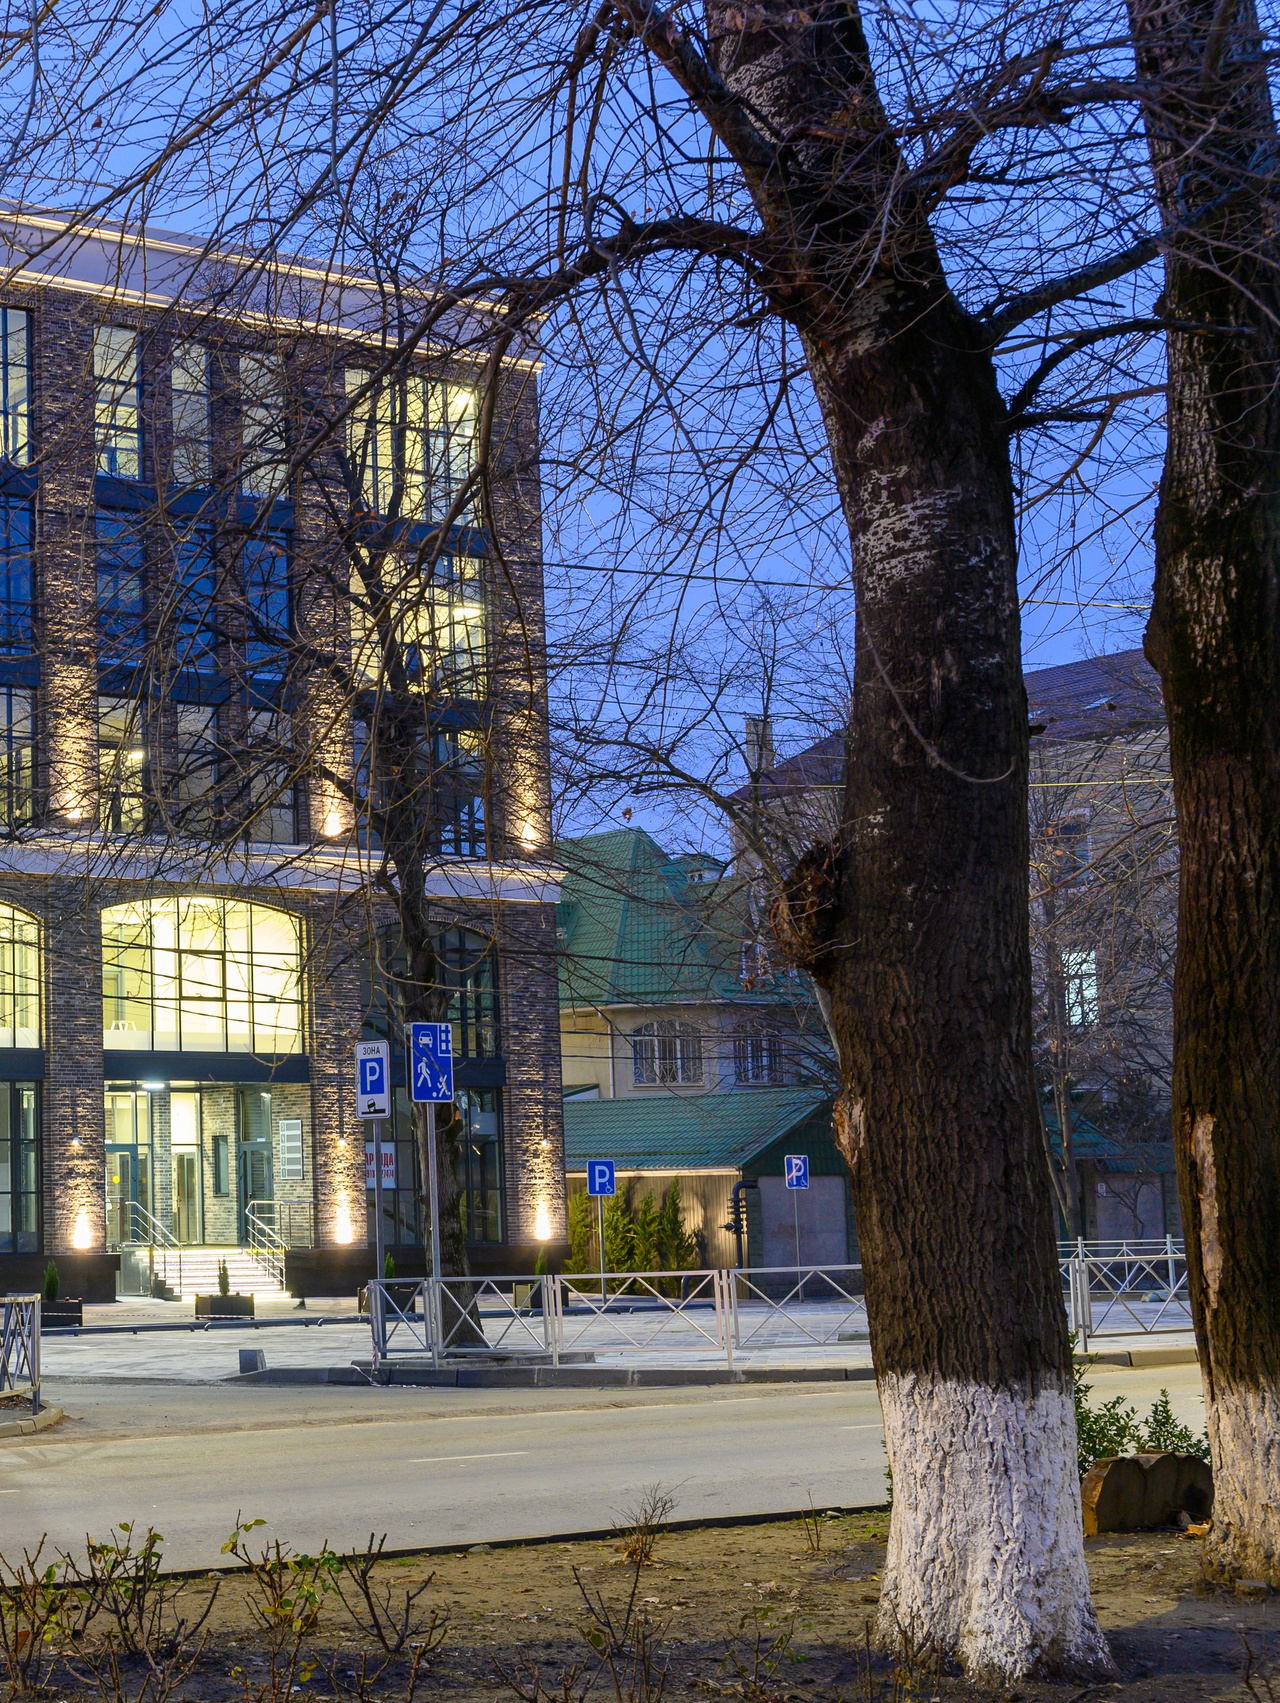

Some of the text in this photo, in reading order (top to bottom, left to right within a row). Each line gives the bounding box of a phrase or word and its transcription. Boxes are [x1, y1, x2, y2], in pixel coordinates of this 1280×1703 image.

[362, 1046, 381, 1056] ЗОНА
[366, 1061, 380, 1092] P
[595, 1165, 610, 1192] P
